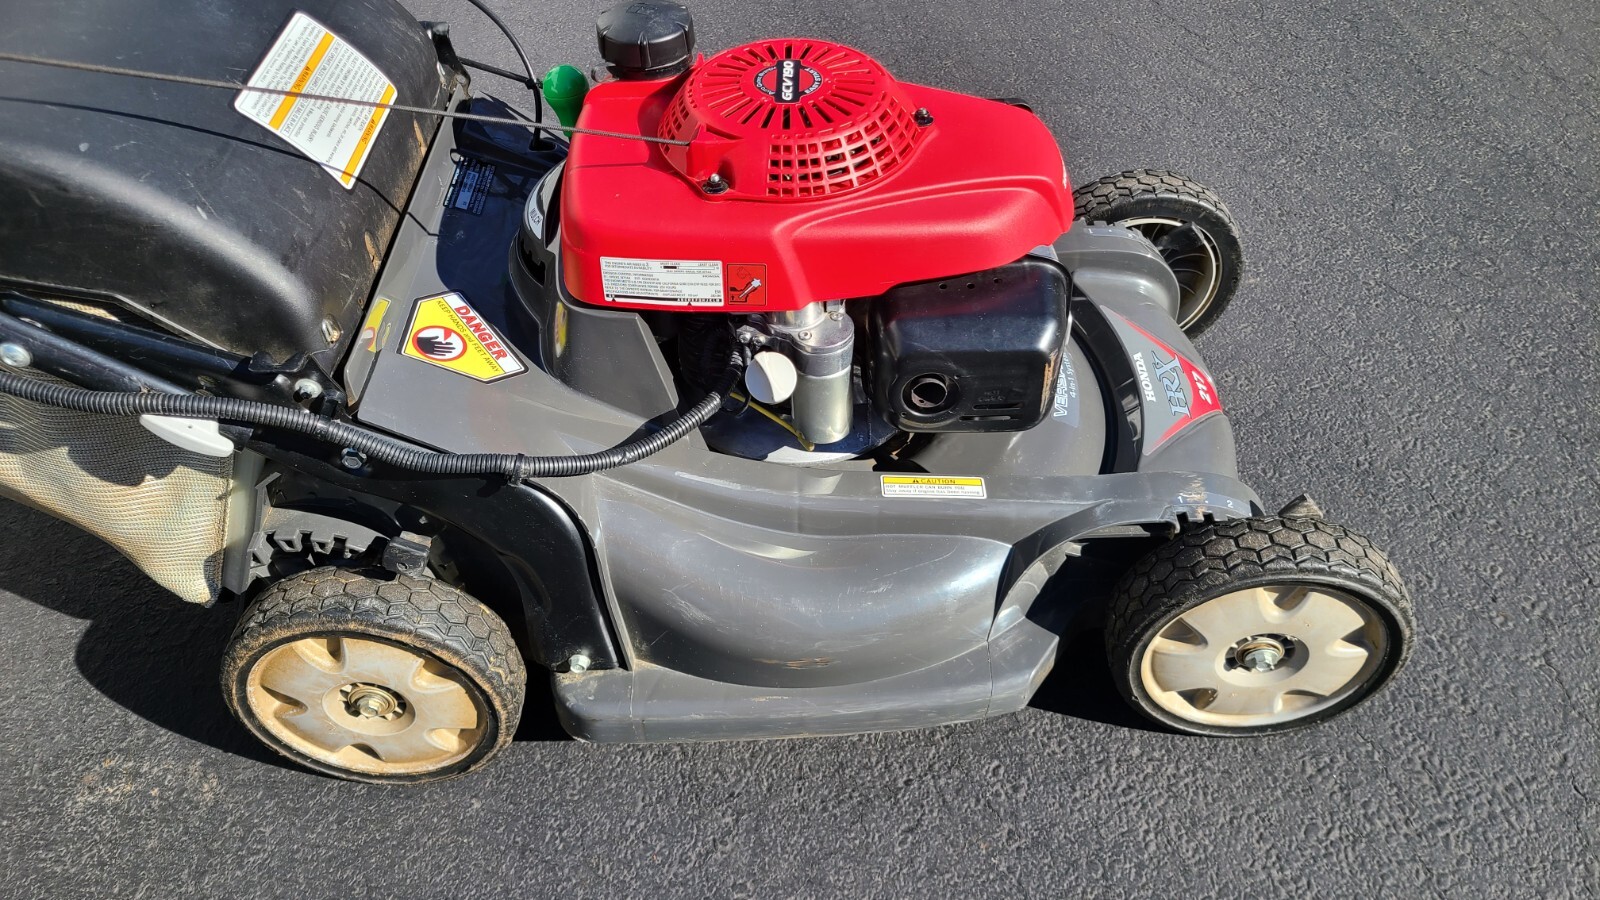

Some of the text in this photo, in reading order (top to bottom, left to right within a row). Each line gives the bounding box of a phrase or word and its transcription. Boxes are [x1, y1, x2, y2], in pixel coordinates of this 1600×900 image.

[293, 69, 310, 92] WARNING
[782, 60, 794, 100] GCV190
[804, 68, 822, 82] START
[360, 123, 374, 144] WARNING
[530, 208, 542, 226] MULCH
[437, 300, 500, 373] KEEP HANDS and FEET AWAY
[454, 305, 507, 361] DANGER
[1133, 352, 1156, 402] HONDA
[1151, 350, 1192, 419] HRX
[1192, 370, 1212, 405] 217
[1226, 500, 1234, 508] 2
